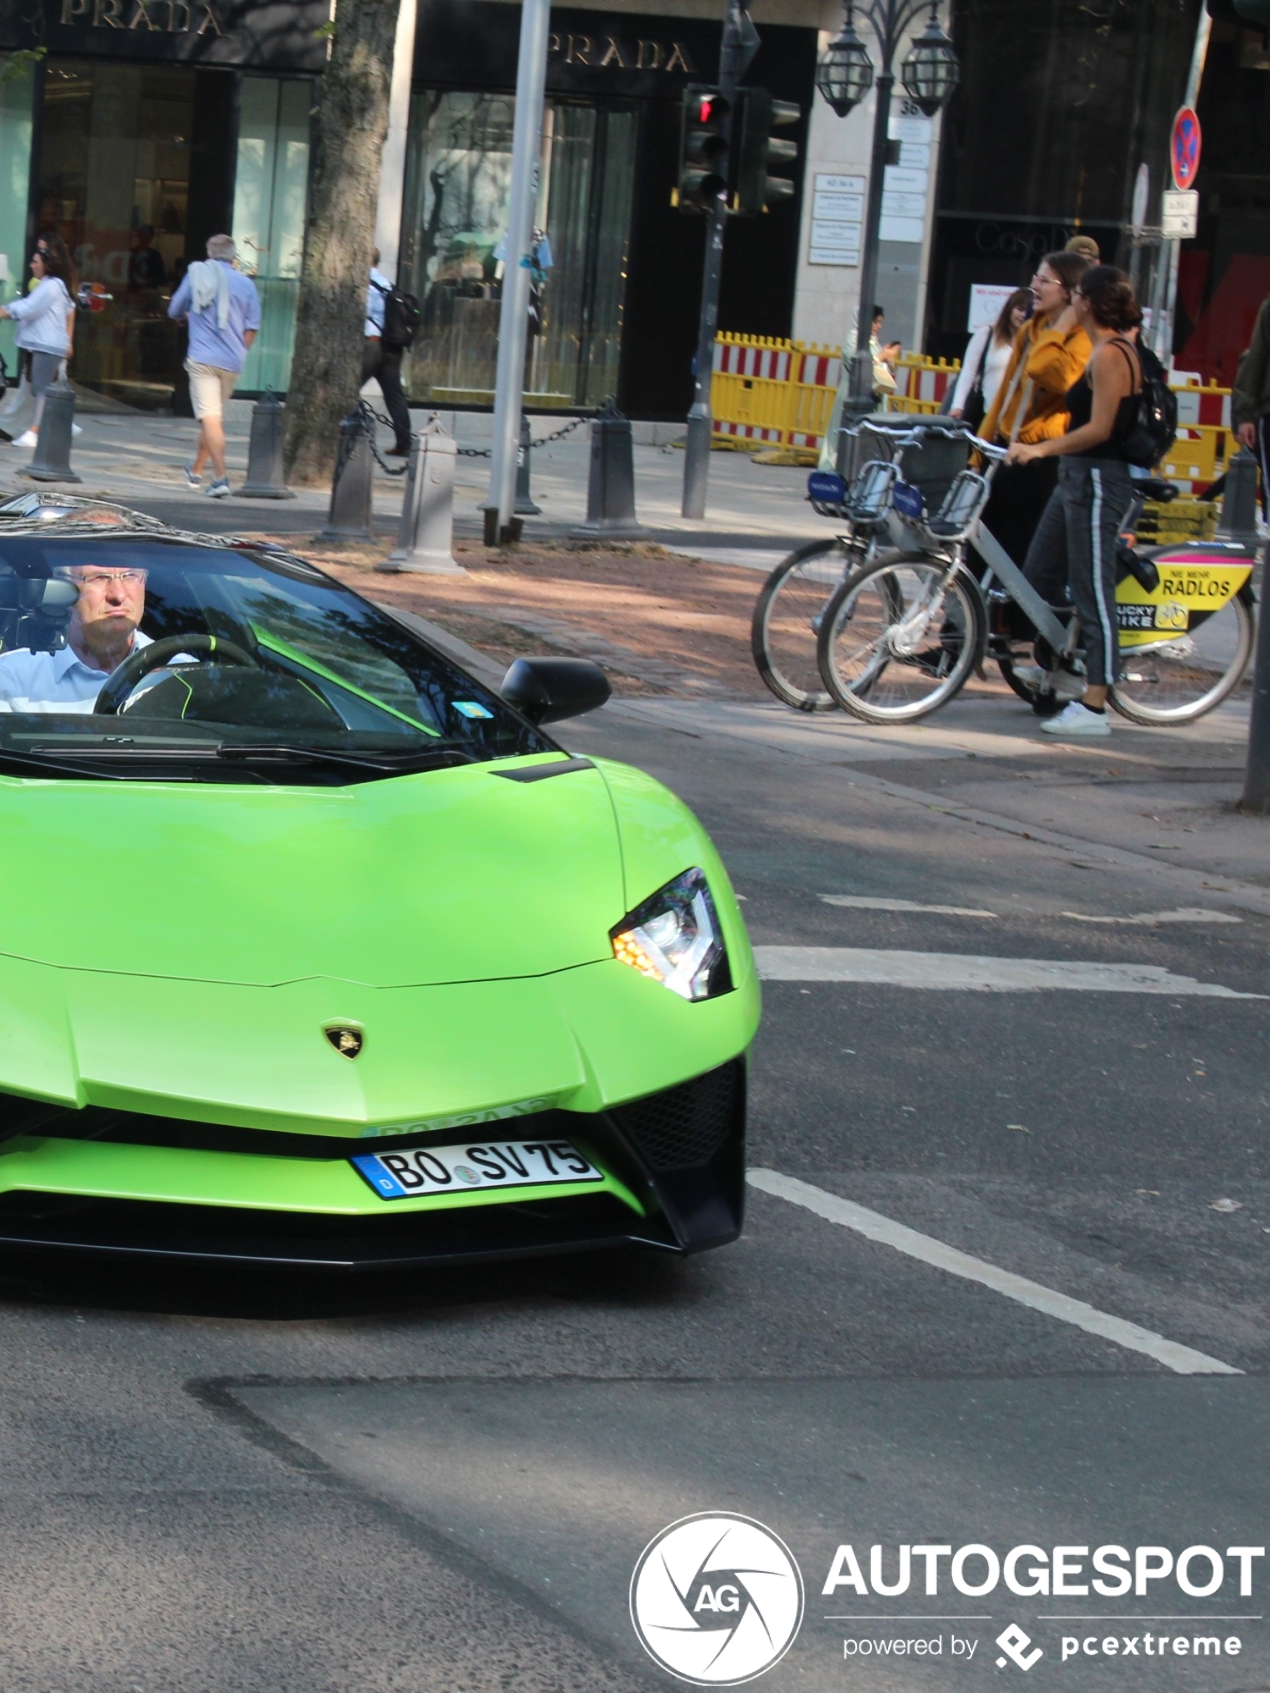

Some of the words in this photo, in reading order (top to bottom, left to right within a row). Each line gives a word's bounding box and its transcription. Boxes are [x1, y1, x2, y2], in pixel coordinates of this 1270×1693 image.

[59, 0, 230, 37] PRADA
[1169, 569, 1184, 579] NIE
[1186, 570, 1211, 579] MEHR
[1162, 578, 1232, 597] RADLOS
[1116, 605, 1155, 616] UCKY
[1116, 615, 1153, 628] IKE
[380, 1151, 452, 1188] BO
